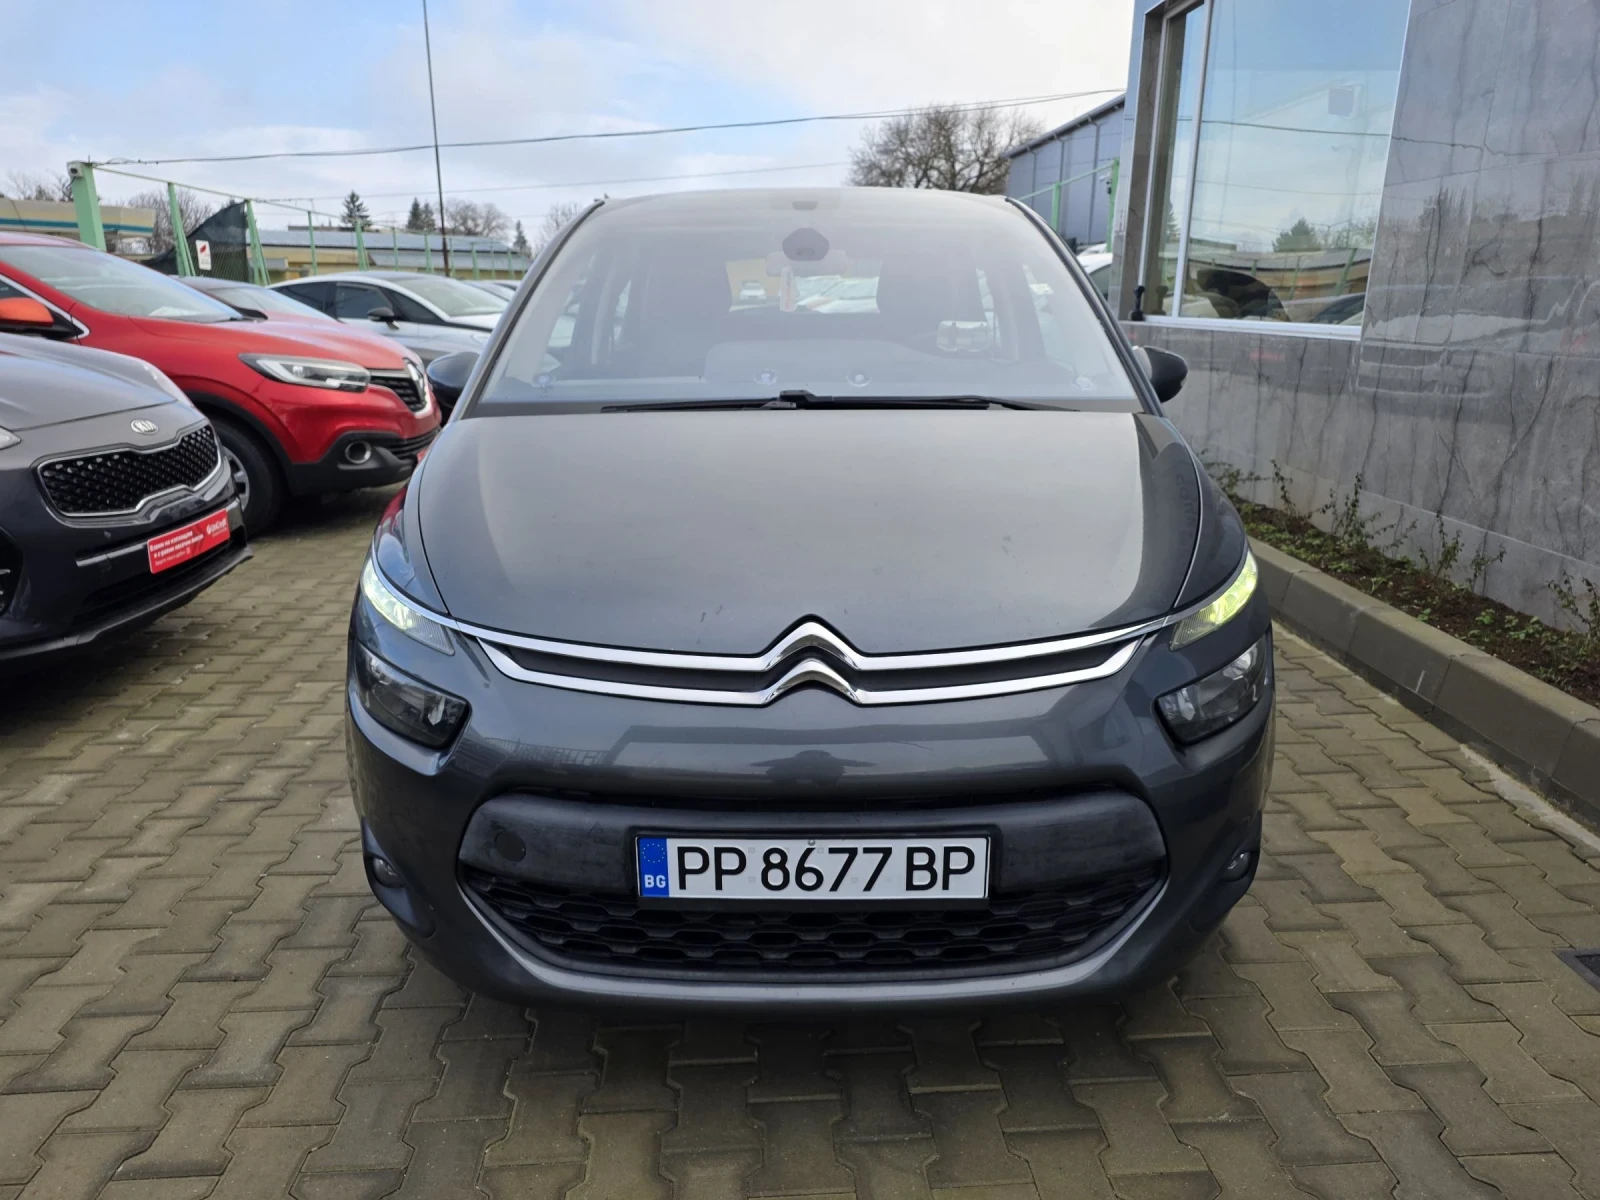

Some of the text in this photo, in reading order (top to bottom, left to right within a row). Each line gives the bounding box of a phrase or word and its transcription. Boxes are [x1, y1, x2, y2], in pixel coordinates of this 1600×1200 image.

[644, 874, 666, 889] BG
[677, 846, 975, 892] PP 8677 BP
